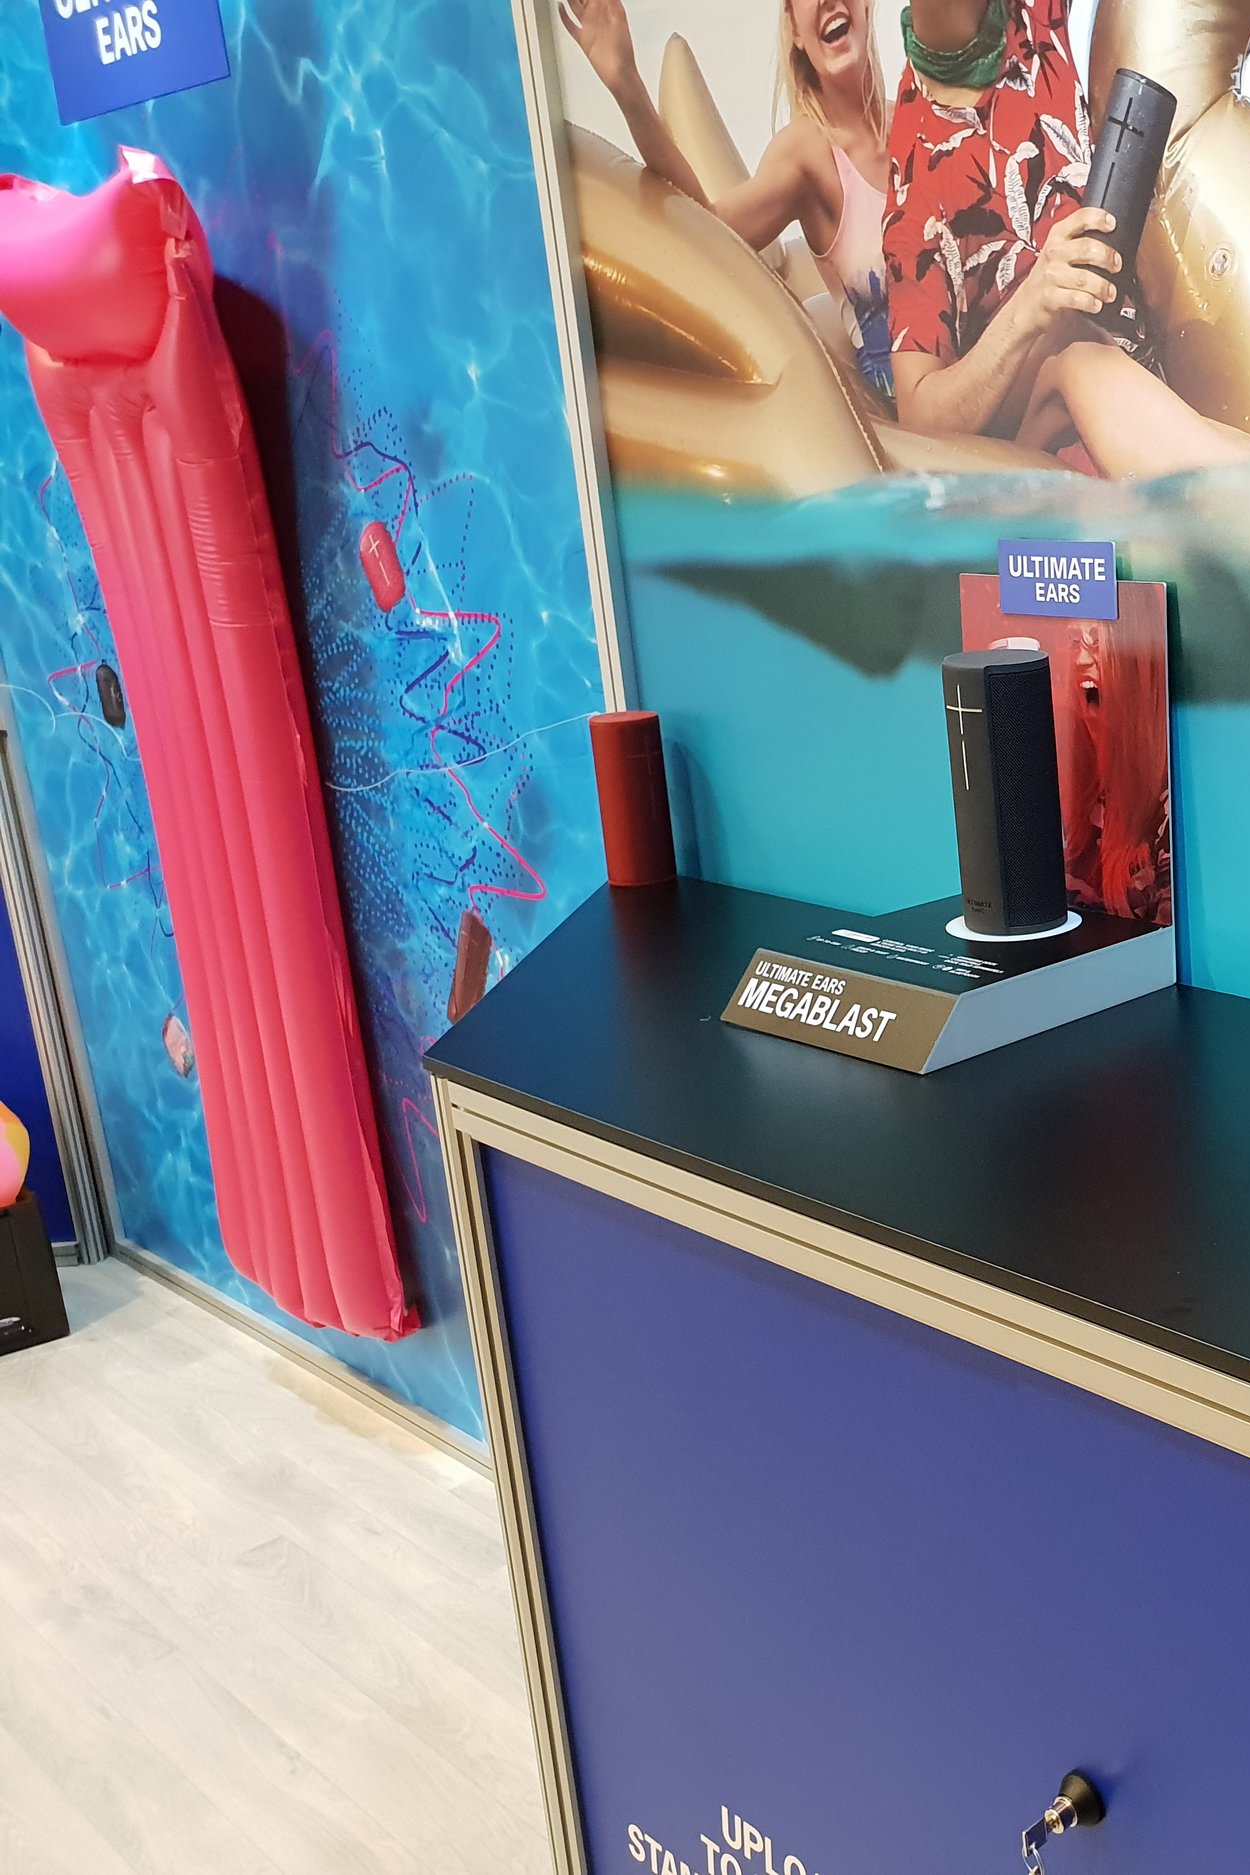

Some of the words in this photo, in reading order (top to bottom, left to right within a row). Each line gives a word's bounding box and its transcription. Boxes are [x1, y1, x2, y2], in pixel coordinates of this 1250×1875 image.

[96, 0, 162, 65] EARS
[1008, 555, 1106, 581] ULTIMATE
[1035, 582, 1081, 603] EARS
[755, 960, 813, 987] ULTIMATE
[811, 974, 846, 995] EARS
[737, 978, 897, 1042] MEGABLAST
[720, 1804, 820, 1875] UPLO
